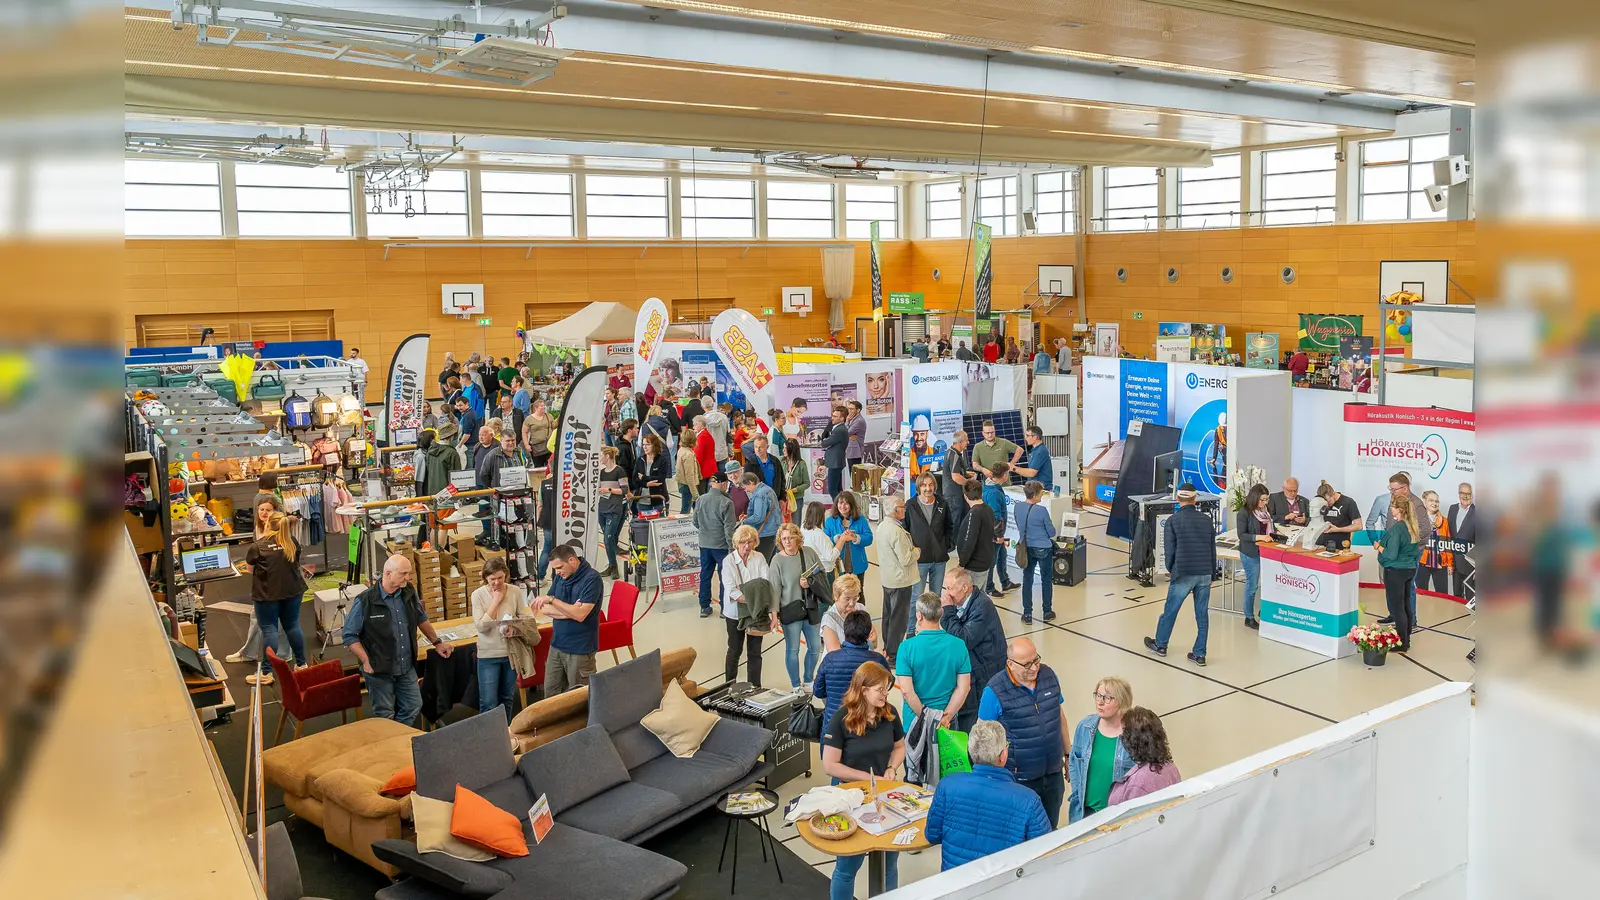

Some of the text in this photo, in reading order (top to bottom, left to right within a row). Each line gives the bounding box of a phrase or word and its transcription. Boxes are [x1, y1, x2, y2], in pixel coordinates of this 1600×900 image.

[891, 297, 910, 305] RASS
[643, 309, 662, 352] ASB
[606, 345, 634, 355] FÜHRER
[920, 375, 941, 383] ENERGIE
[1127, 374, 1147, 383] Erneuere
[1199, 377, 1228, 389] ENERG
[1125, 383, 1142, 391] Energie,
[1126, 390, 1139, 398] Deine
[1139, 391, 1150, 399] Welt
[1129, 408, 1158, 417] regenerativen
[1370, 438, 1424, 449] HÖRAKUSTIK
[1357, 443, 1425, 459] HONISCH
[1455, 457, 1471, 465] Pegnitz
[1454, 465, 1474, 473] Auerbach
[561, 431, 574, 519] SPORTHAUS
[659, 530, 699, 540] SCHUH-WOCHEN
[1438, 540, 1466, 552] gutes
[1275, 574, 1308, 590] HONISCH
[1287, 610, 1317, 622] Hörexperten
